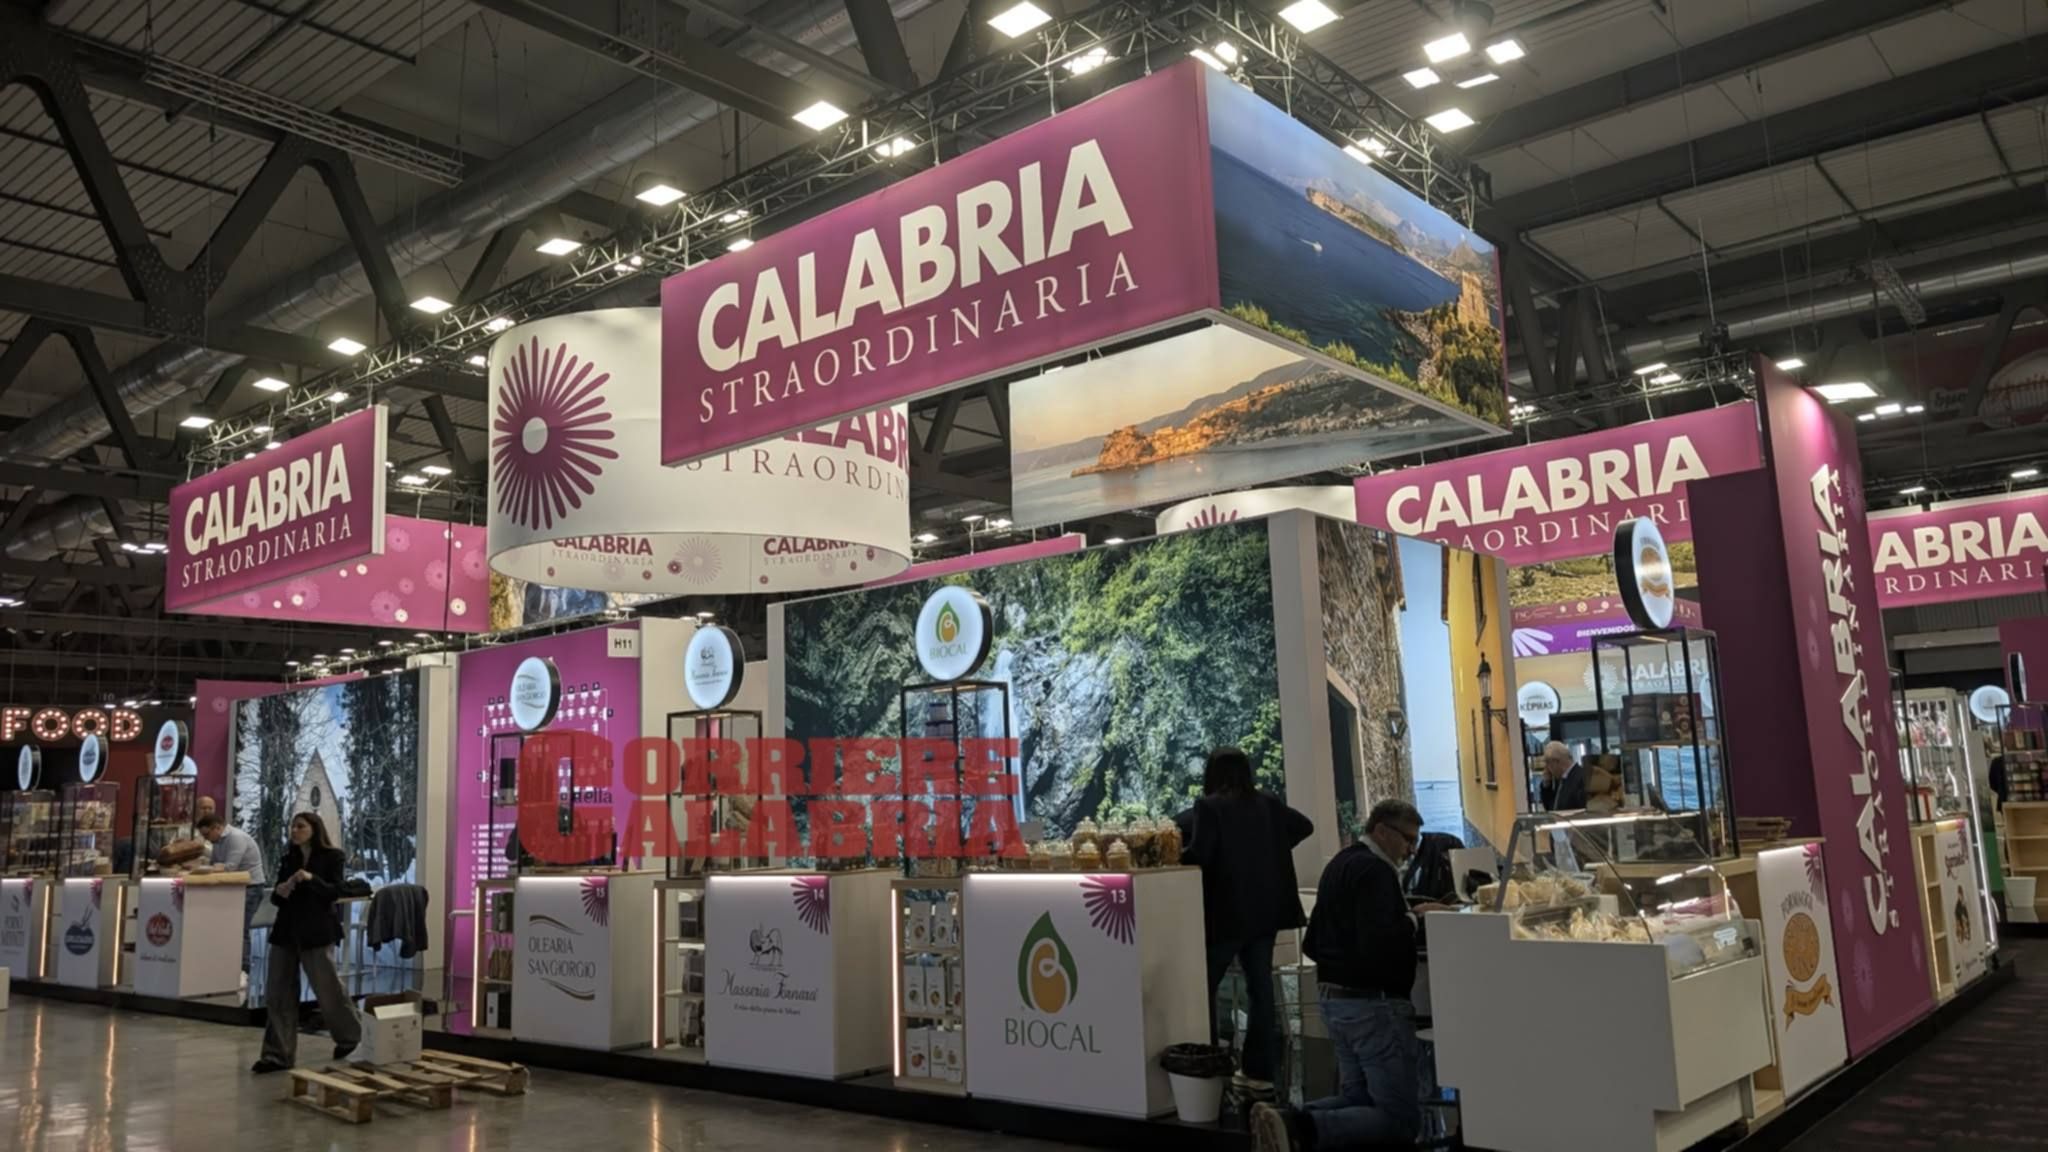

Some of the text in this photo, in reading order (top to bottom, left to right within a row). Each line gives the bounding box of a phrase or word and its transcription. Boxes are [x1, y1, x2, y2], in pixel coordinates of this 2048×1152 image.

[698, 138, 1133, 372] CALABRIA
[699, 251, 1139, 424] STRAORDINARIA
[184, 443, 352, 555] CALABRIA
[1386, 434, 1710, 536] CALABRIA
[182, 513, 352, 588] STRAORDINARIA
[1873, 511, 2048, 574] ABRIA
[1885, 559, 2040, 595] RDINARI
[614, 638, 633, 649] H11
[1576, 624, 1636, 638] BIENVENIDOS
[1810, 464, 1888, 935] CALABRIA
[1, 707, 143, 742] FOOD
[813, 888, 825, 901] 14
[1111, 889, 1127, 904] 13
[528, 936, 574, 955] OLEARIA
[1004, 1017, 1102, 1055] BIOCAL
